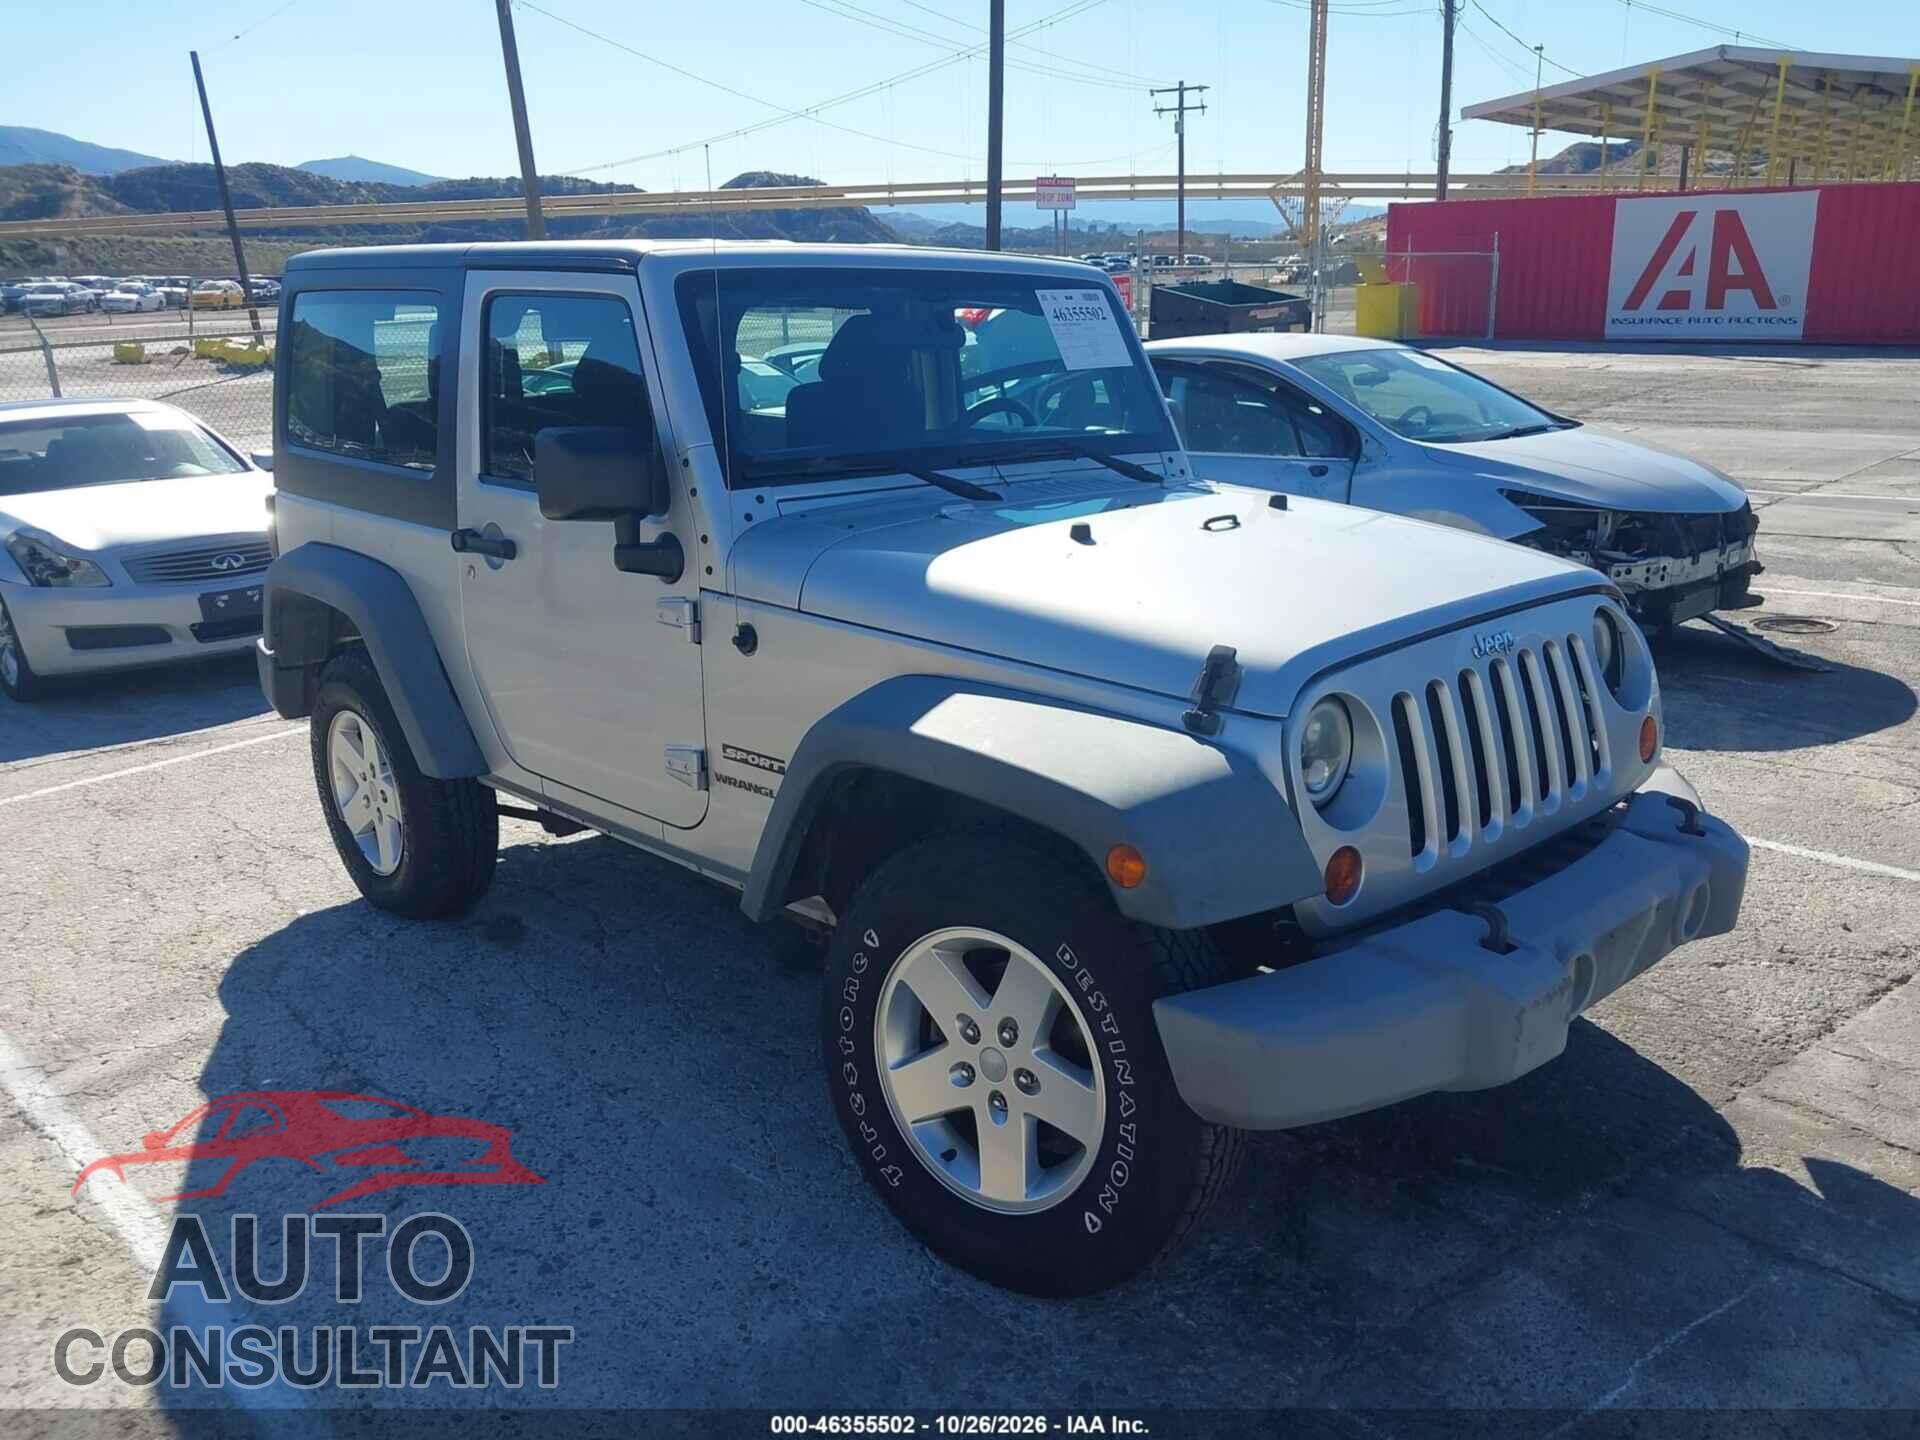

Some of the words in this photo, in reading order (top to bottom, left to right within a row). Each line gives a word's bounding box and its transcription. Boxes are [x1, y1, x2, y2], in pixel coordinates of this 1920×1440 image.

[1053, 306, 1107, 321] 46355502
[1611, 316, 1683, 326] INSURANCE
[1688, 316, 1724, 326] AUTO
[1728, 316, 1798, 326] AUCTIONS
[1472, 631, 1514, 659] Jeep
[725, 747, 785, 771] SPORT
[1056, 943, 1137, 1214] DESTINATION
